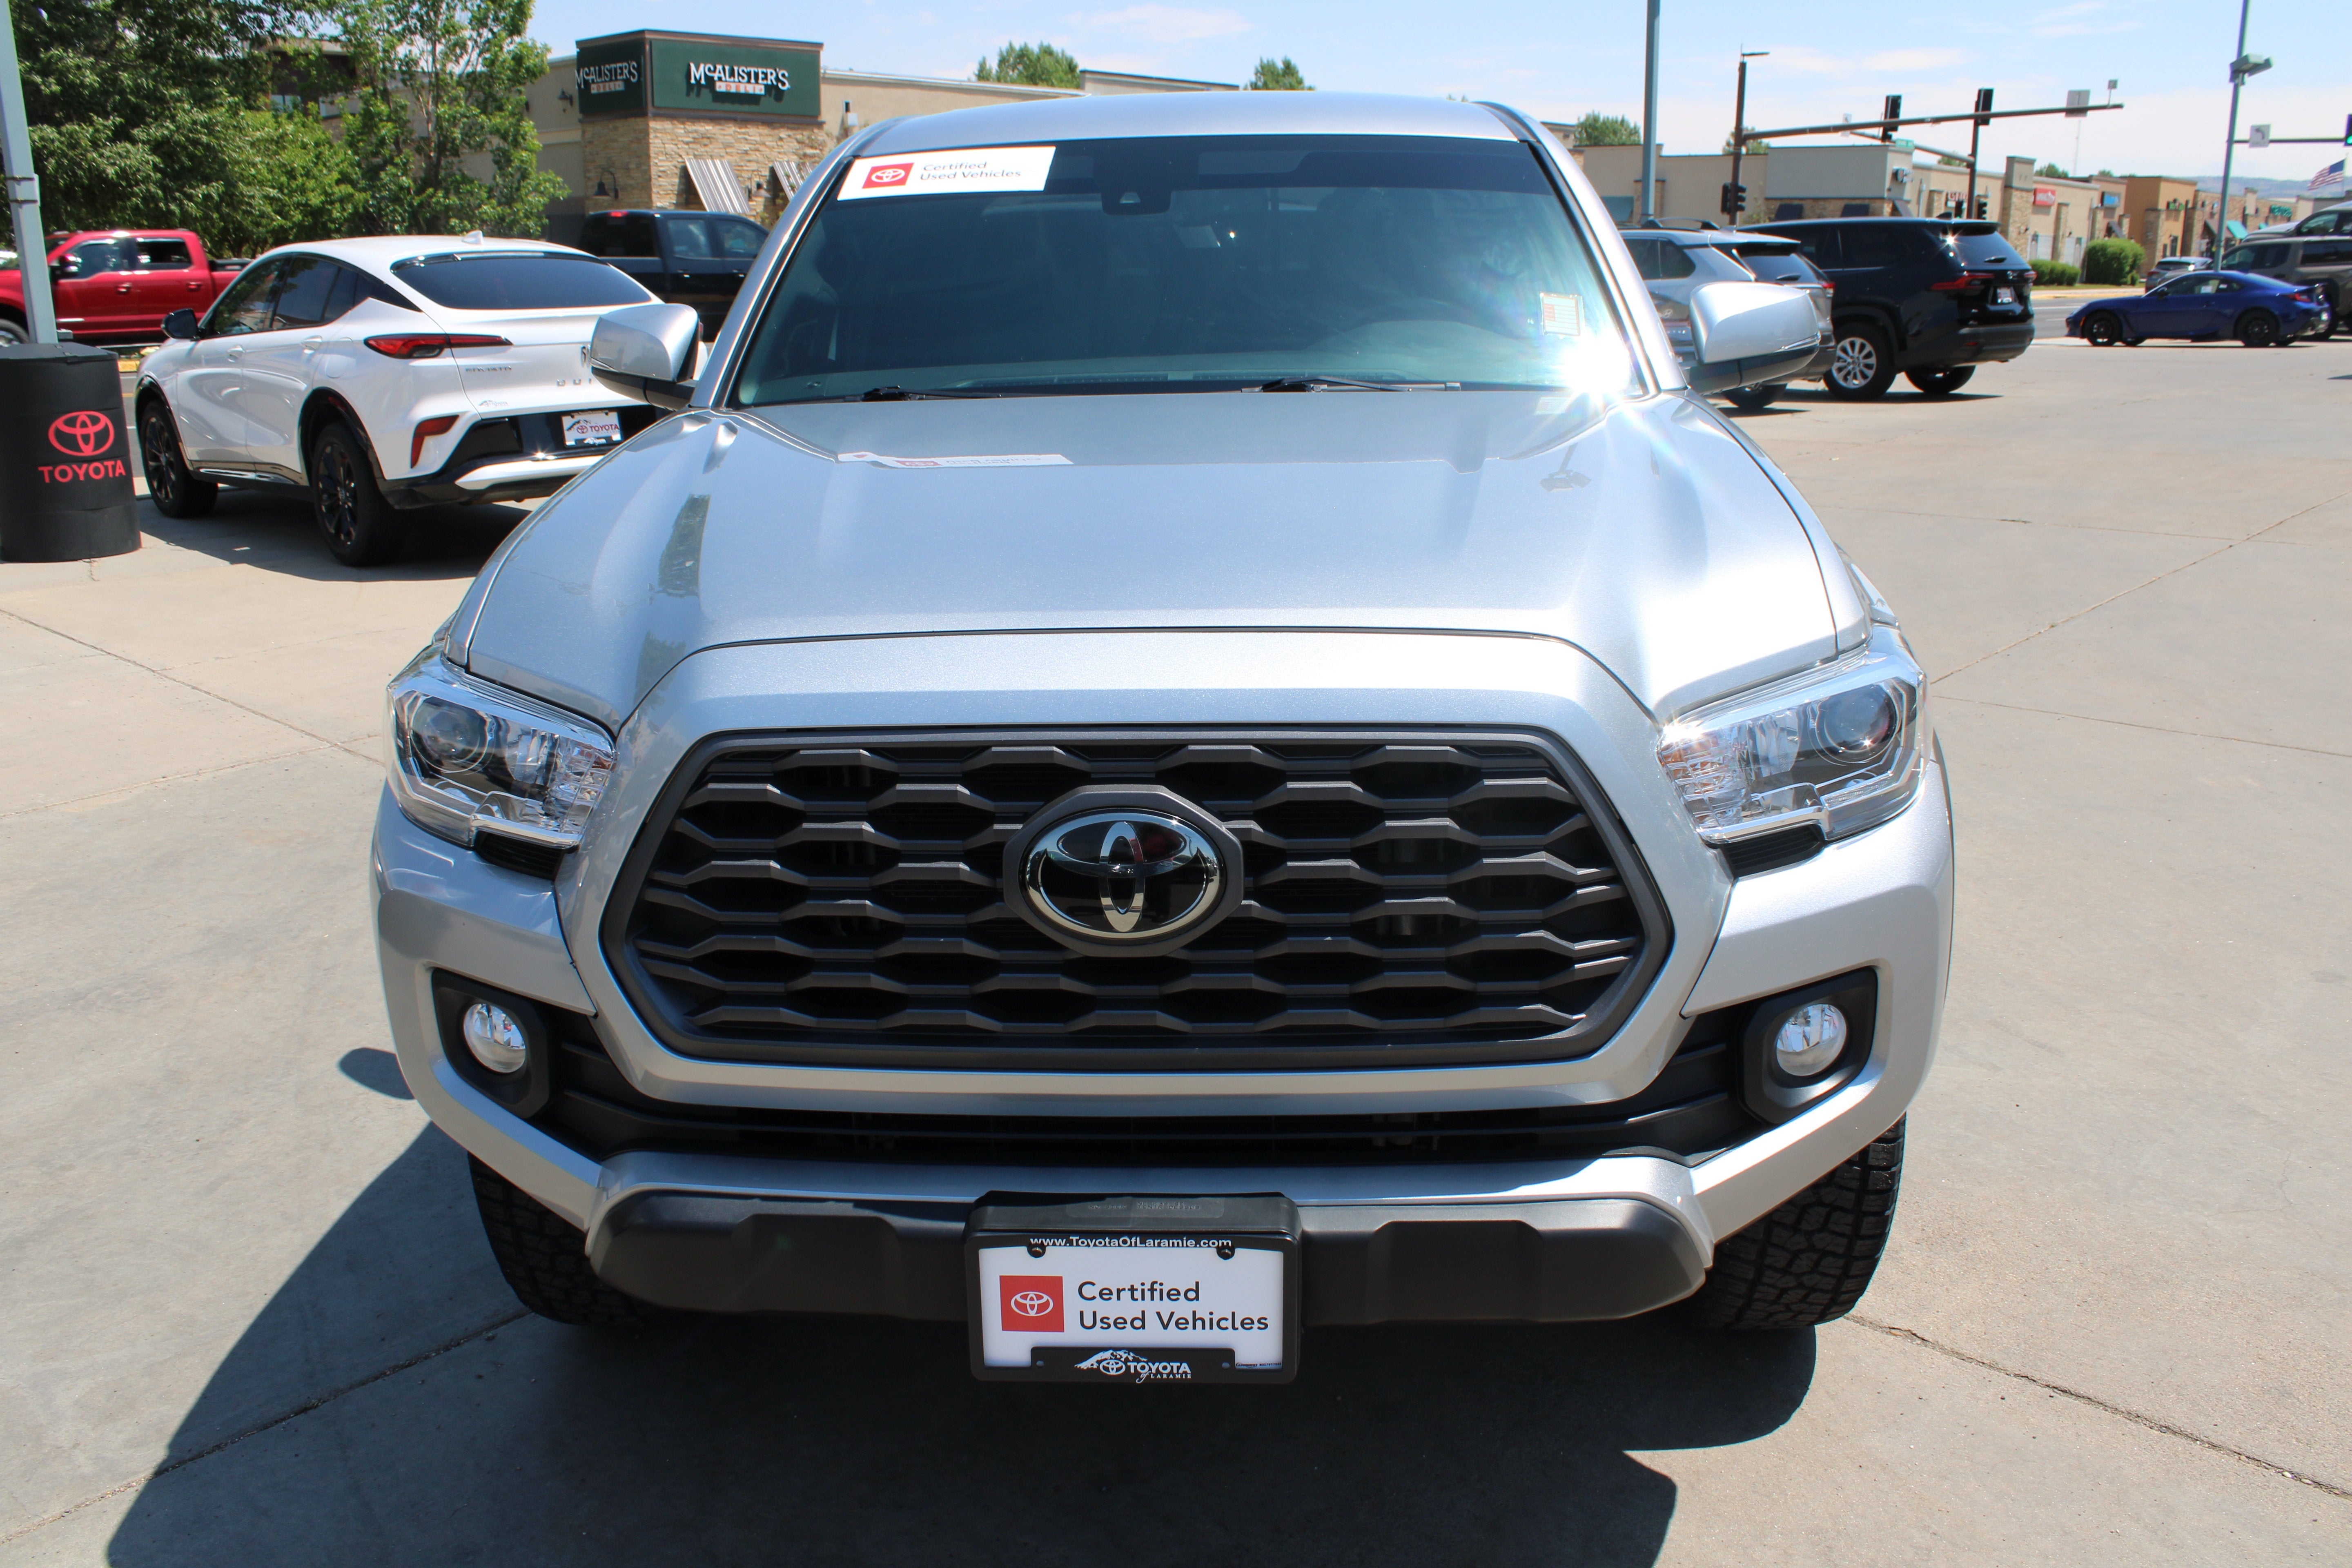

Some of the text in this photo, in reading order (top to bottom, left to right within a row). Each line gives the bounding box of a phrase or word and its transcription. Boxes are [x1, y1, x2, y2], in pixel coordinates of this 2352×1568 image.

[725, 83, 756, 93] DELI
[923, 161, 987, 172] Certified
[920, 170, 1021, 180] Used Vehicles
[556, 378, 592, 387] BUI
[589, 423, 620, 432] TOYOTA
[38, 460, 126, 483] TOYOTA
[1030, 1236, 1232, 1248] www.ToyotaOfLaramie.com
[1078, 1281, 1200, 1302] Certified
[1079, 1310, 1269, 1331] Used Vehicles
[1127, 1362, 1192, 1374] TOYOTA
